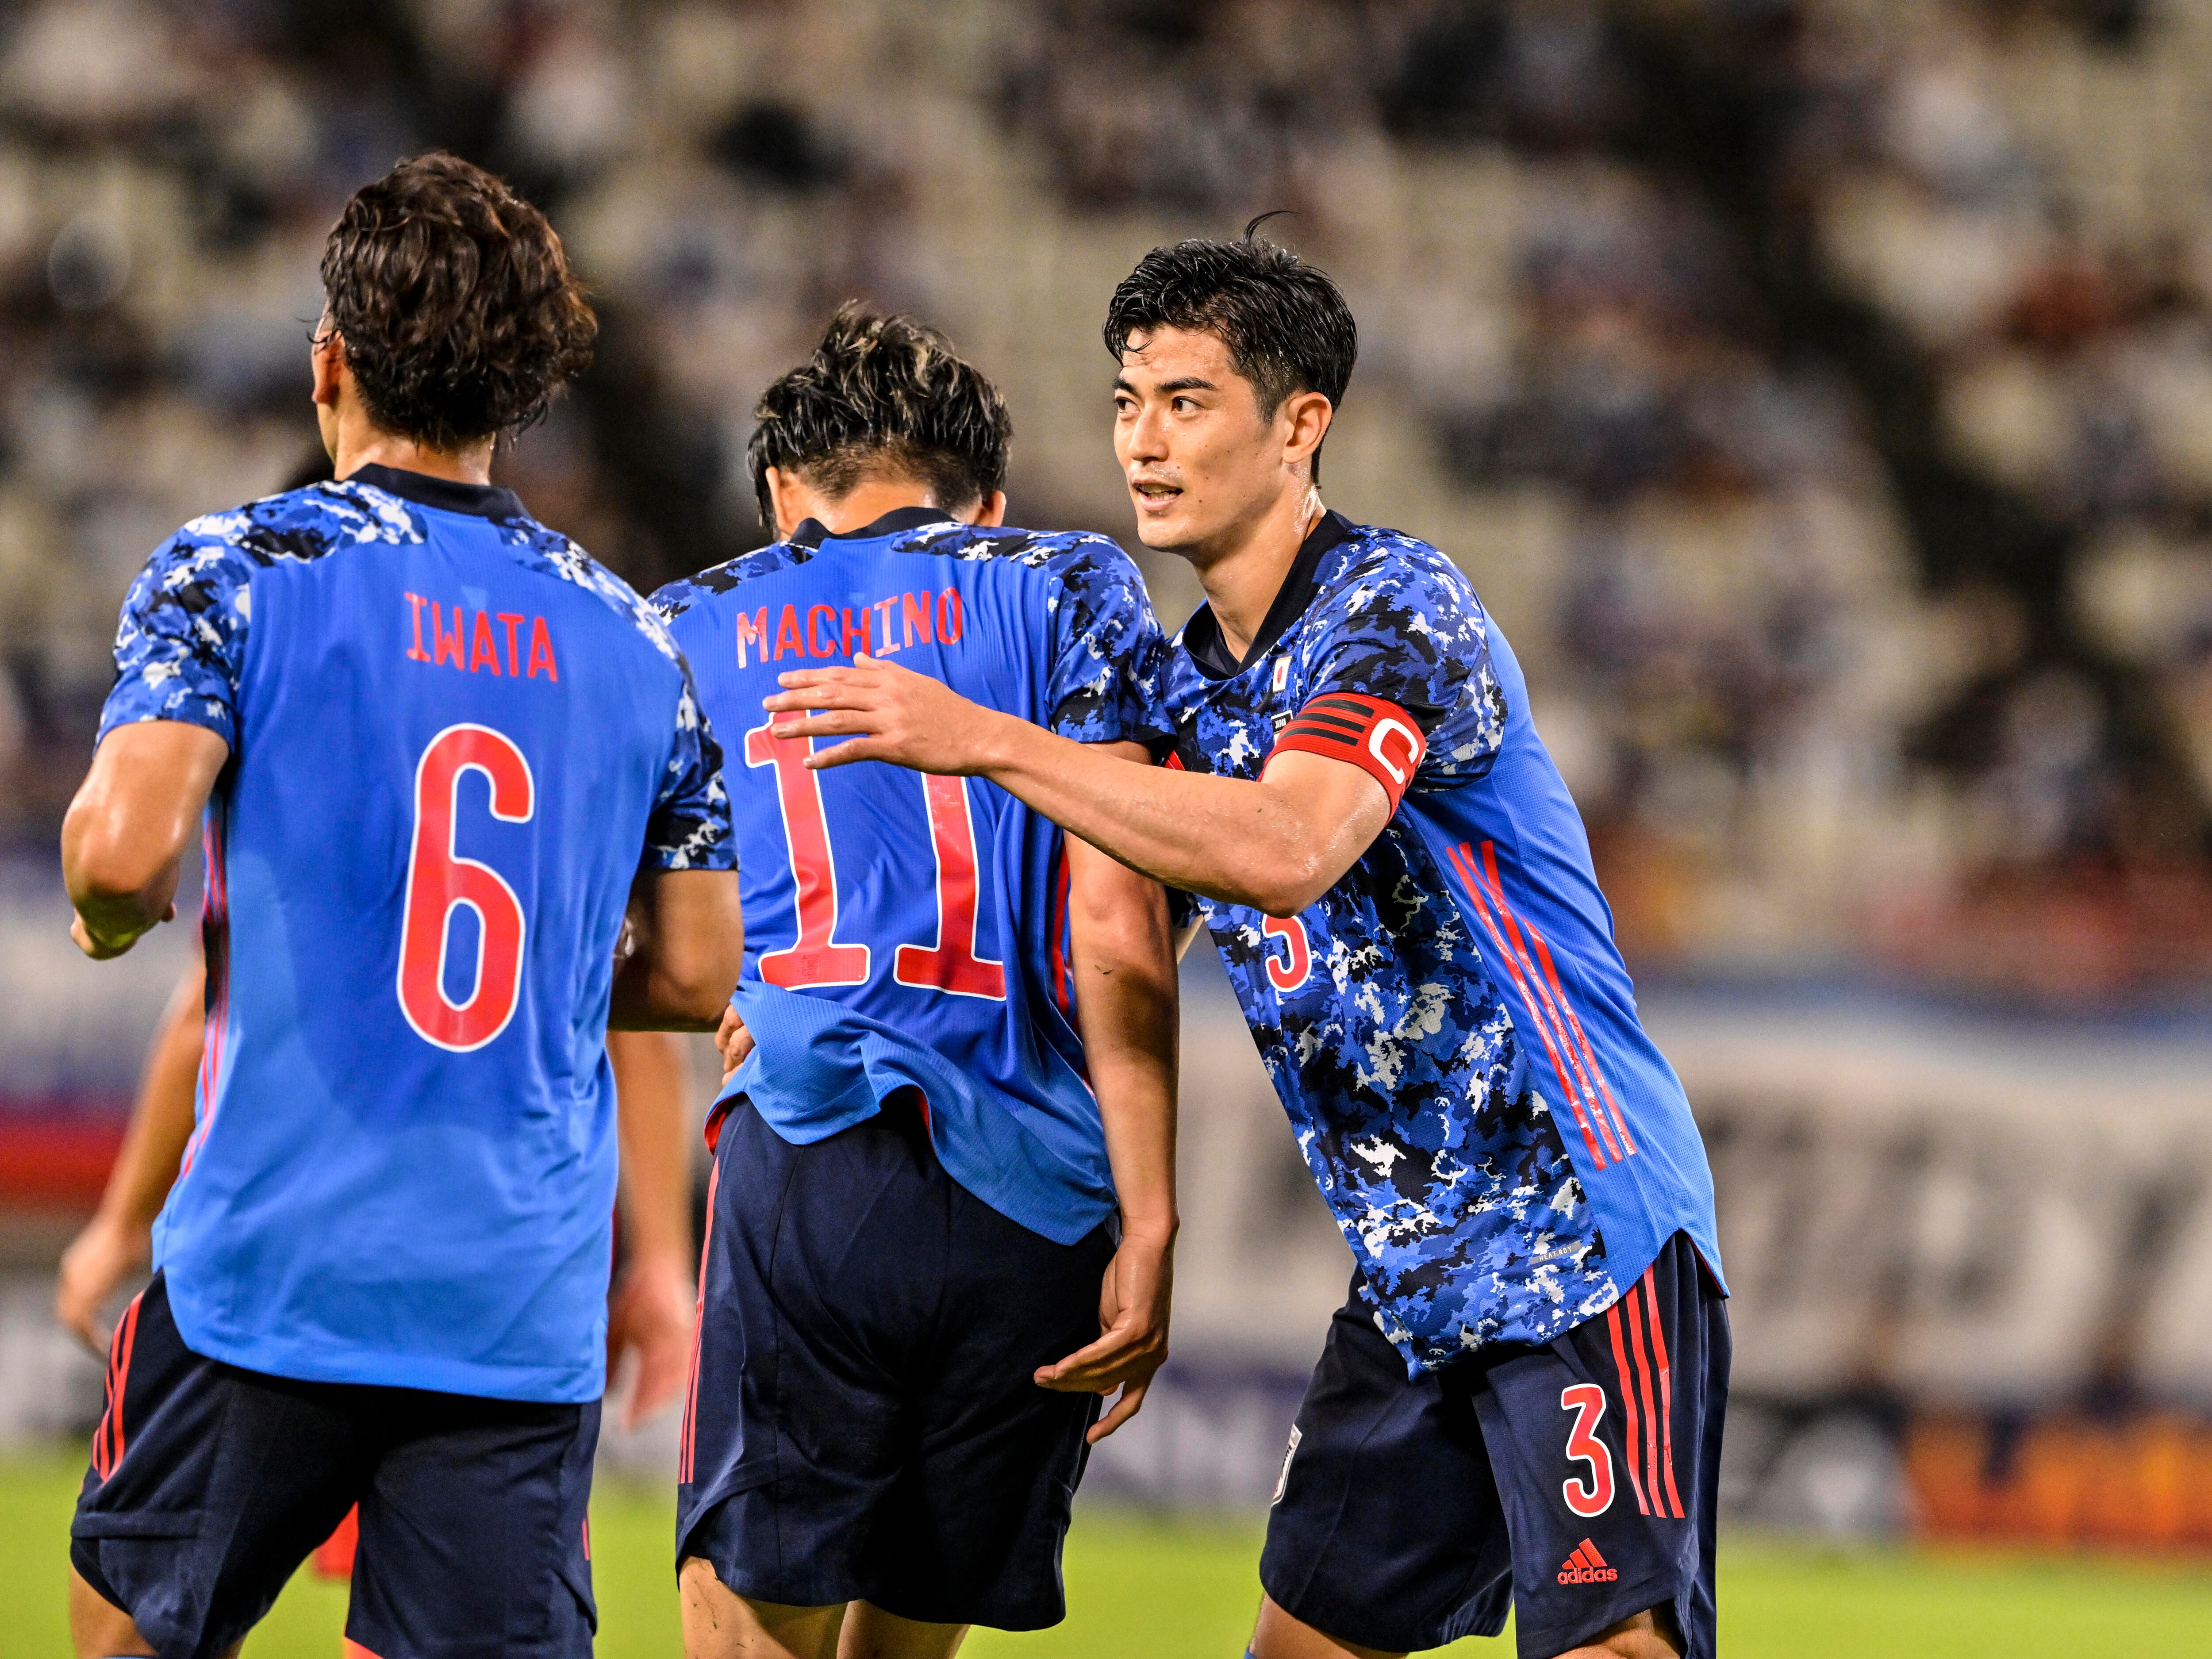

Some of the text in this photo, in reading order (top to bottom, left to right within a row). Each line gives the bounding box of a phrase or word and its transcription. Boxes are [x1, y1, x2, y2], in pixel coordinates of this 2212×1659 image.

[405, 592, 558, 682] IWATA
[737, 588, 963, 668] MACHINO
[1275, 718, 1286, 729] JAPAN
[1368, 718, 1419, 784] C
[396, 722, 534, 1052] 6
[745, 709, 1006, 1001] 11
[1540, 1246, 1572, 1261] HEAT.RDY
[1561, 1383, 1615, 1517] 3
[1558, 1567, 1617, 1585] adidas
